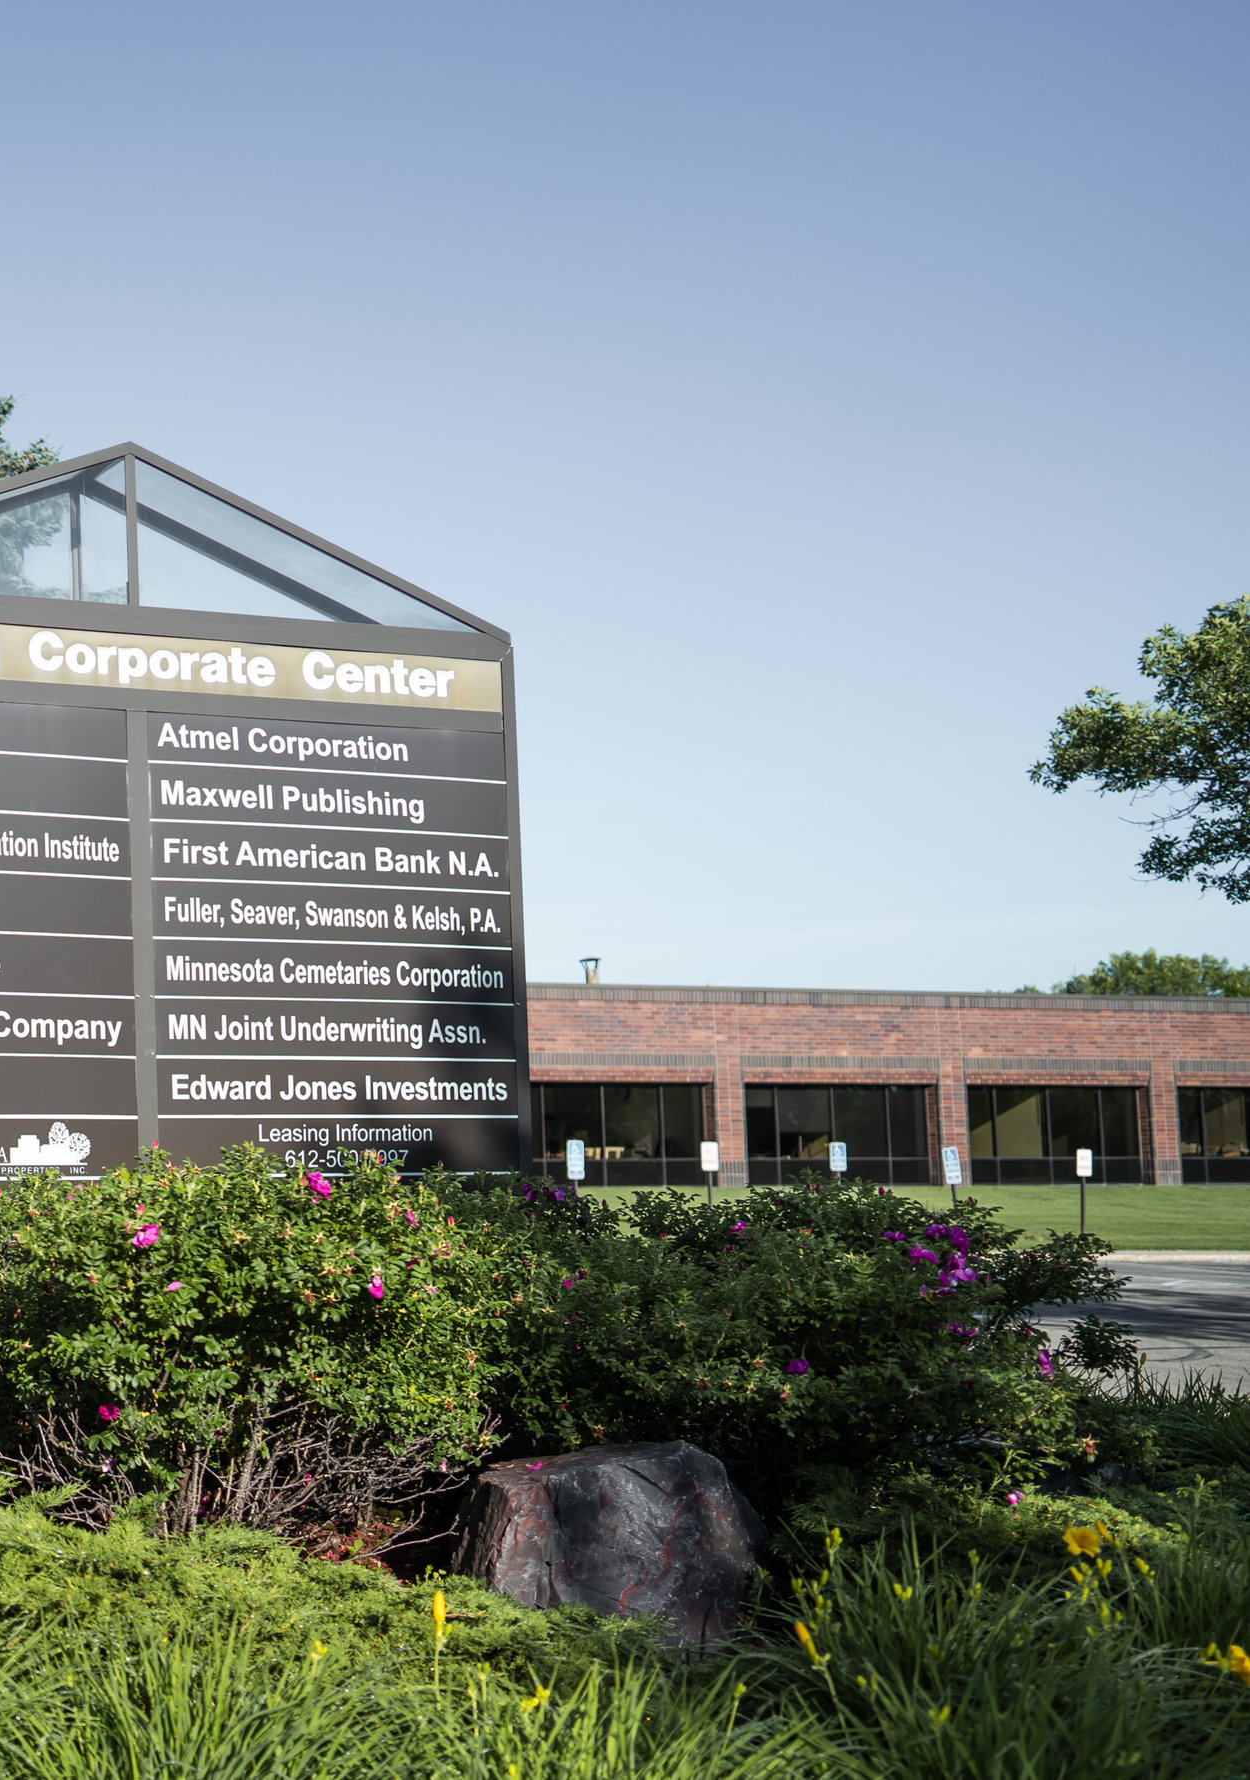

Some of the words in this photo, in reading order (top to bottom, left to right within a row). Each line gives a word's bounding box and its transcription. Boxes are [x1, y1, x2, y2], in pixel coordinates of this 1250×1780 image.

[28, 630, 276, 687] Corporate
[302, 650, 455, 698] Center
[157, 722, 240, 751] Atmel
[247, 728, 410, 762] Corporation
[160, 779, 274, 810] Maxwell
[282, 785, 425, 824] Publishing
[44, 832, 120, 863] Institute
[163, 837, 230, 866] First
[235, 840, 367, 871] American
[374, 846, 442, 875] Bank
[448, 850, 499, 878] N.A.
[164, 896, 225, 929] Fuller,
[230, 897, 300, 931] Seaver,
[305, 900, 389, 929] Swanson
[393, 903, 408, 930] &
[411, 904, 466, 936] Kelsh,
[469, 907, 501, 934] P.A.
[165, 954, 275, 983] Minnesota
[279, 957, 391, 986] Cemetaries
[395, 960, 504, 993] Corporation
[168, 1013, 207, 1040] MN
[213, 1014, 274, 1041] Joint
[280, 1015, 423, 1050] Underwriting
[428, 1018, 486, 1044] Assn.
[171, 1073, 272, 1101] Edward
[279, 1074, 357, 1101] Jones
[364, 1074, 508, 1101] Investments
[258, 1123, 330, 1147] Leasing
[335, 1123, 433, 1142] Information
[1, 1166, 61, 1175] PROPERTS
[69, 1166, 89, 1175] INC.
